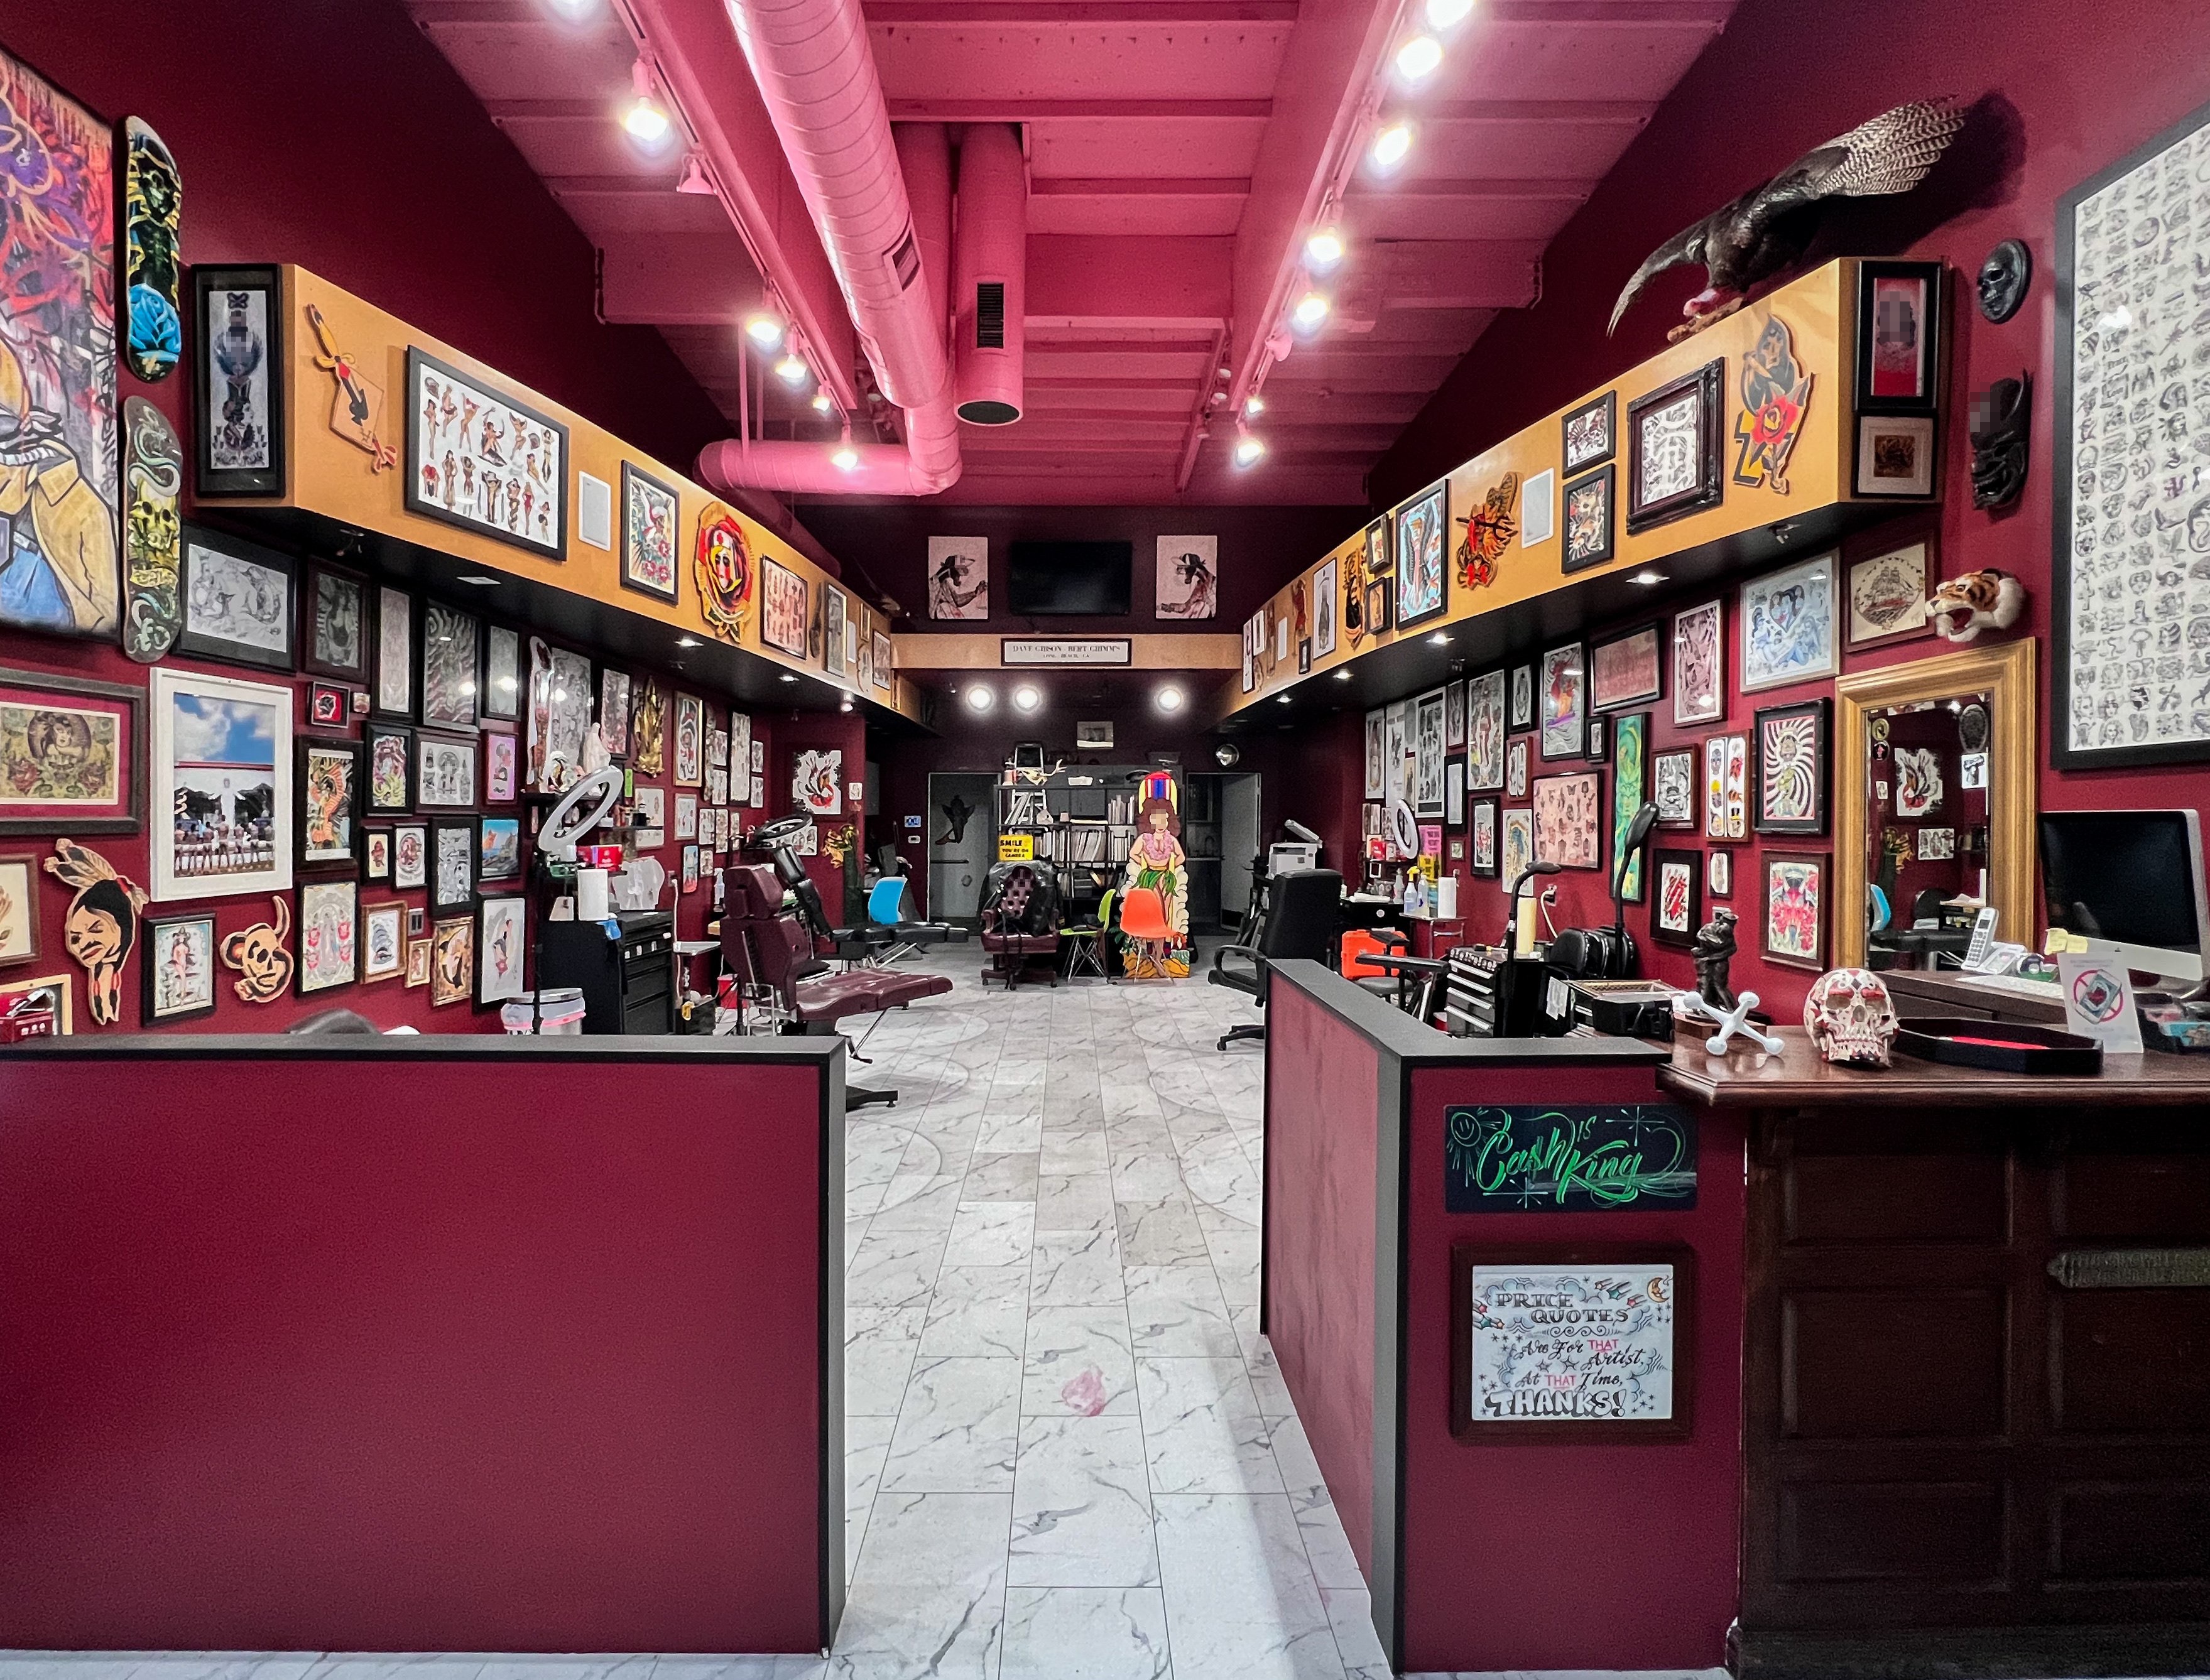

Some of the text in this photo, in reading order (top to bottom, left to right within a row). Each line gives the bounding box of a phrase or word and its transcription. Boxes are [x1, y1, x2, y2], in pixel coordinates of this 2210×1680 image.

[1476, 1113, 1574, 1191] Cash
[1556, 1139, 1644, 1204] King
[1496, 1293, 1574, 1308] PRICE
[1530, 1308, 1630, 1325] QUOTES
[1549, 1340, 1583, 1360] For
[1587, 1339, 1619, 1351] THAT
[1515, 1370, 1540, 1387] At
[1545, 1374, 1577, 1387] THAT
[1484, 1388, 1627, 1417] THANKS!
